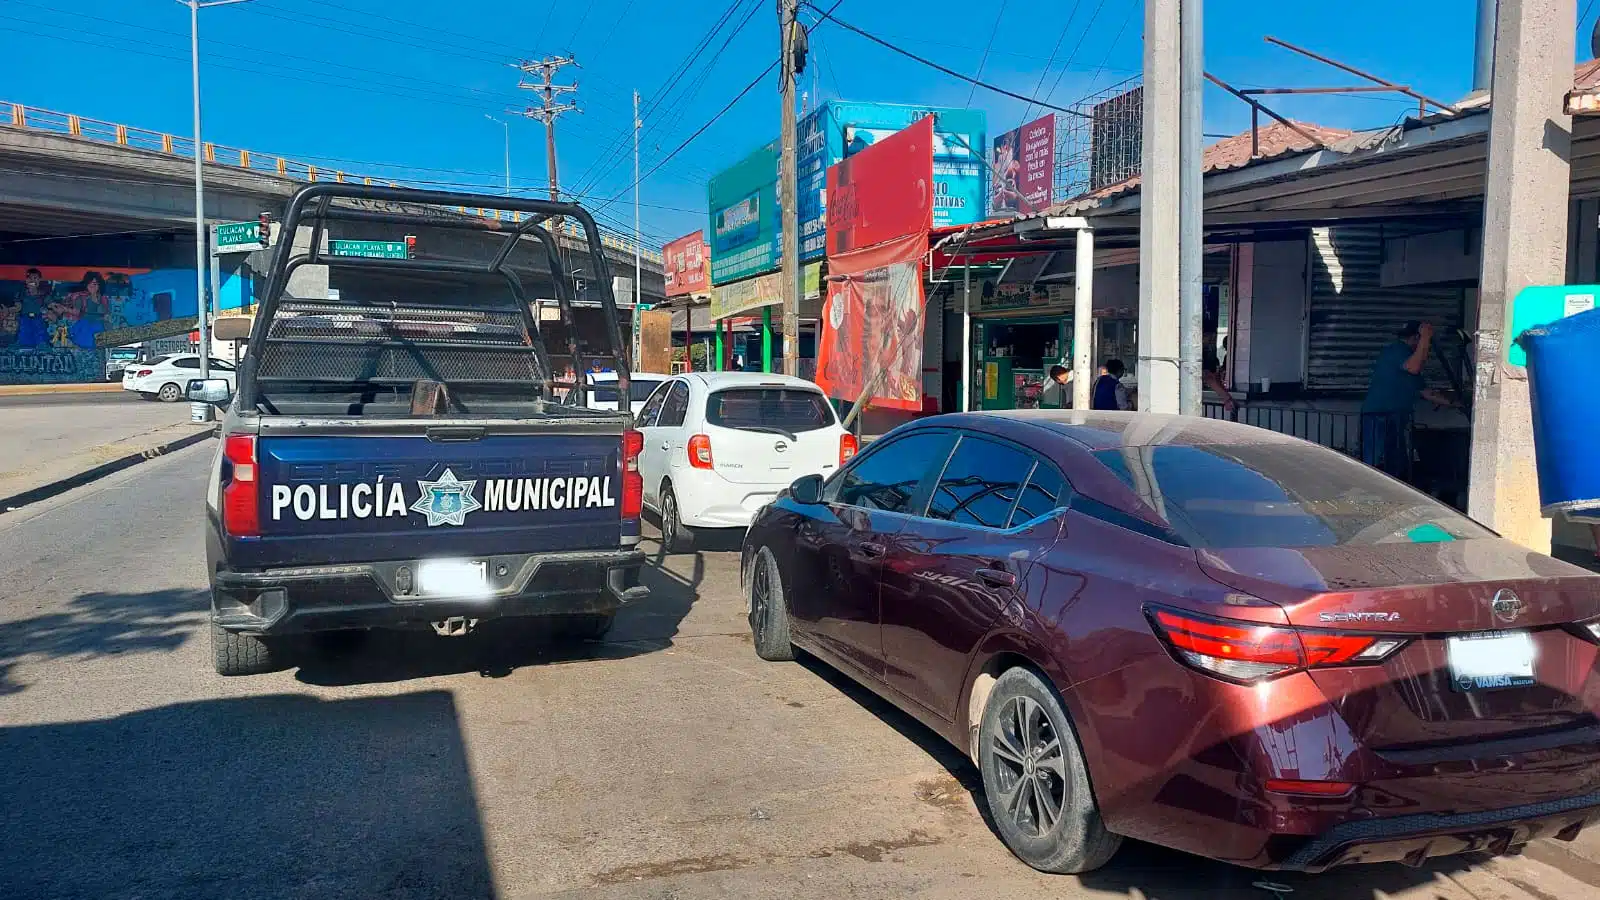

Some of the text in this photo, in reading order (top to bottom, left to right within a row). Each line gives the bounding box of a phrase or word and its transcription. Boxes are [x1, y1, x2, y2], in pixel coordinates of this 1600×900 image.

[222, 235, 243, 244] PLAYAS
[271, 474, 615, 521] POLICÍA MUNICIPAL
[1319, 611, 1401, 623] SENTRA
[1474, 675, 1512, 689] VAMSA
